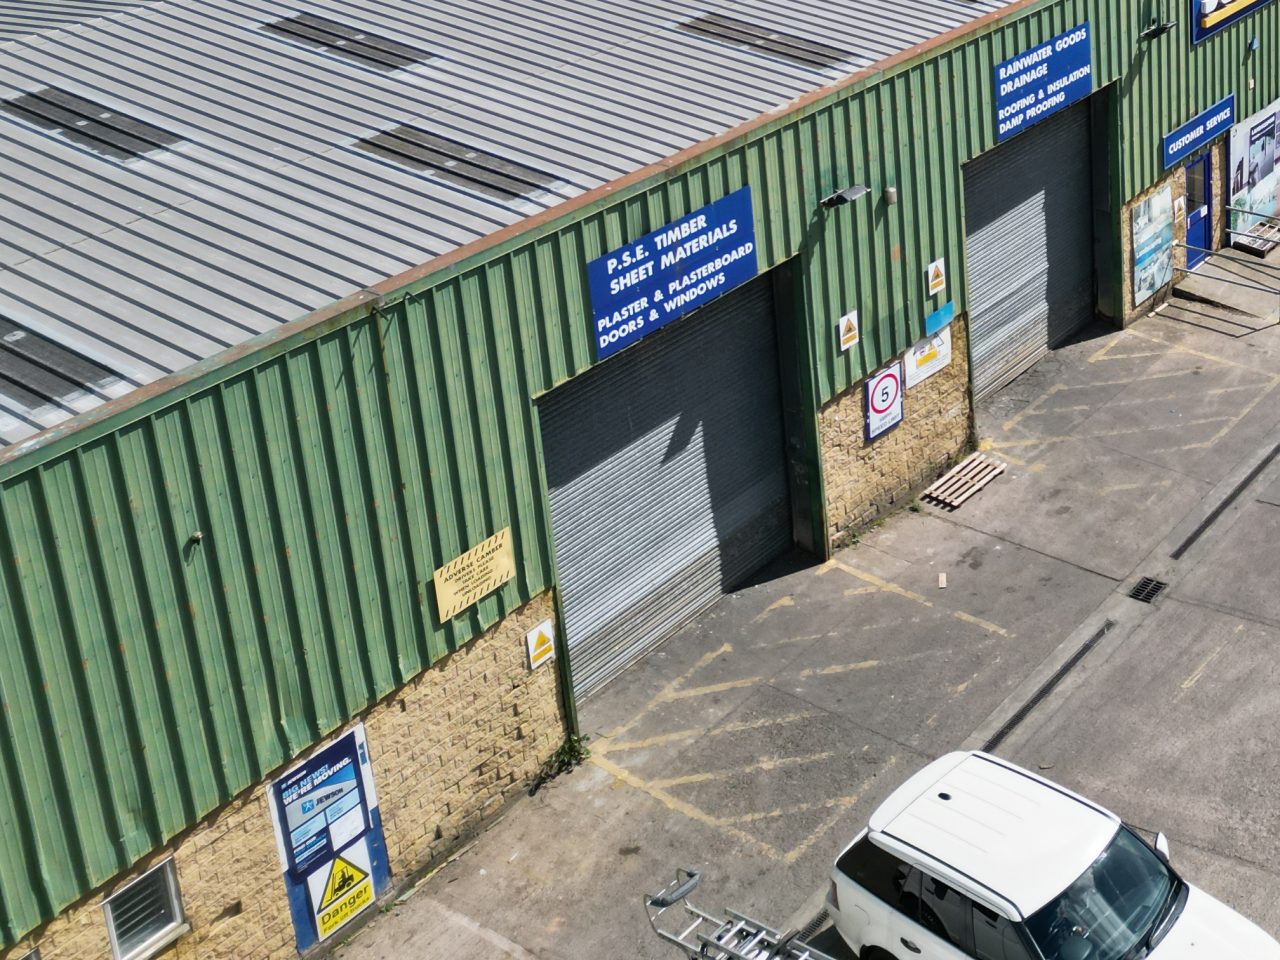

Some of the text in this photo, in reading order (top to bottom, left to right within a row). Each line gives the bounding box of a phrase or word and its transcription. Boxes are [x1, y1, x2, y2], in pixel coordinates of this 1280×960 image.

[999, 28, 1087, 80] RAINWATER GOODS
[998, 64, 1091, 120] ROOFING & INSULATION
[1000, 63, 1048, 96] DRAINAGE
[999, 92, 1065, 134] DAMP PROOFING
[1168, 126, 1204, 154] CUSTOMER
[1206, 107, 1231, 131] SERVICE
[607, 214, 707, 274] P.S.E. TIMBER
[610, 219, 738, 295] SHEET MATERIALS
[597, 242, 753, 332] PLASTER & PLASTERBOARD
[600, 272, 726, 348] DOORS & WINDOWS
[881, 386, 889, 402] 5
[444, 543, 503, 584] ADVERSE CAMBER
[282, 764, 329, 800] BIG NEWS!
[314, 757, 352, 785] MOVING.
[316, 787, 344, 806] JEWSON
[321, 885, 369, 926] Danger
